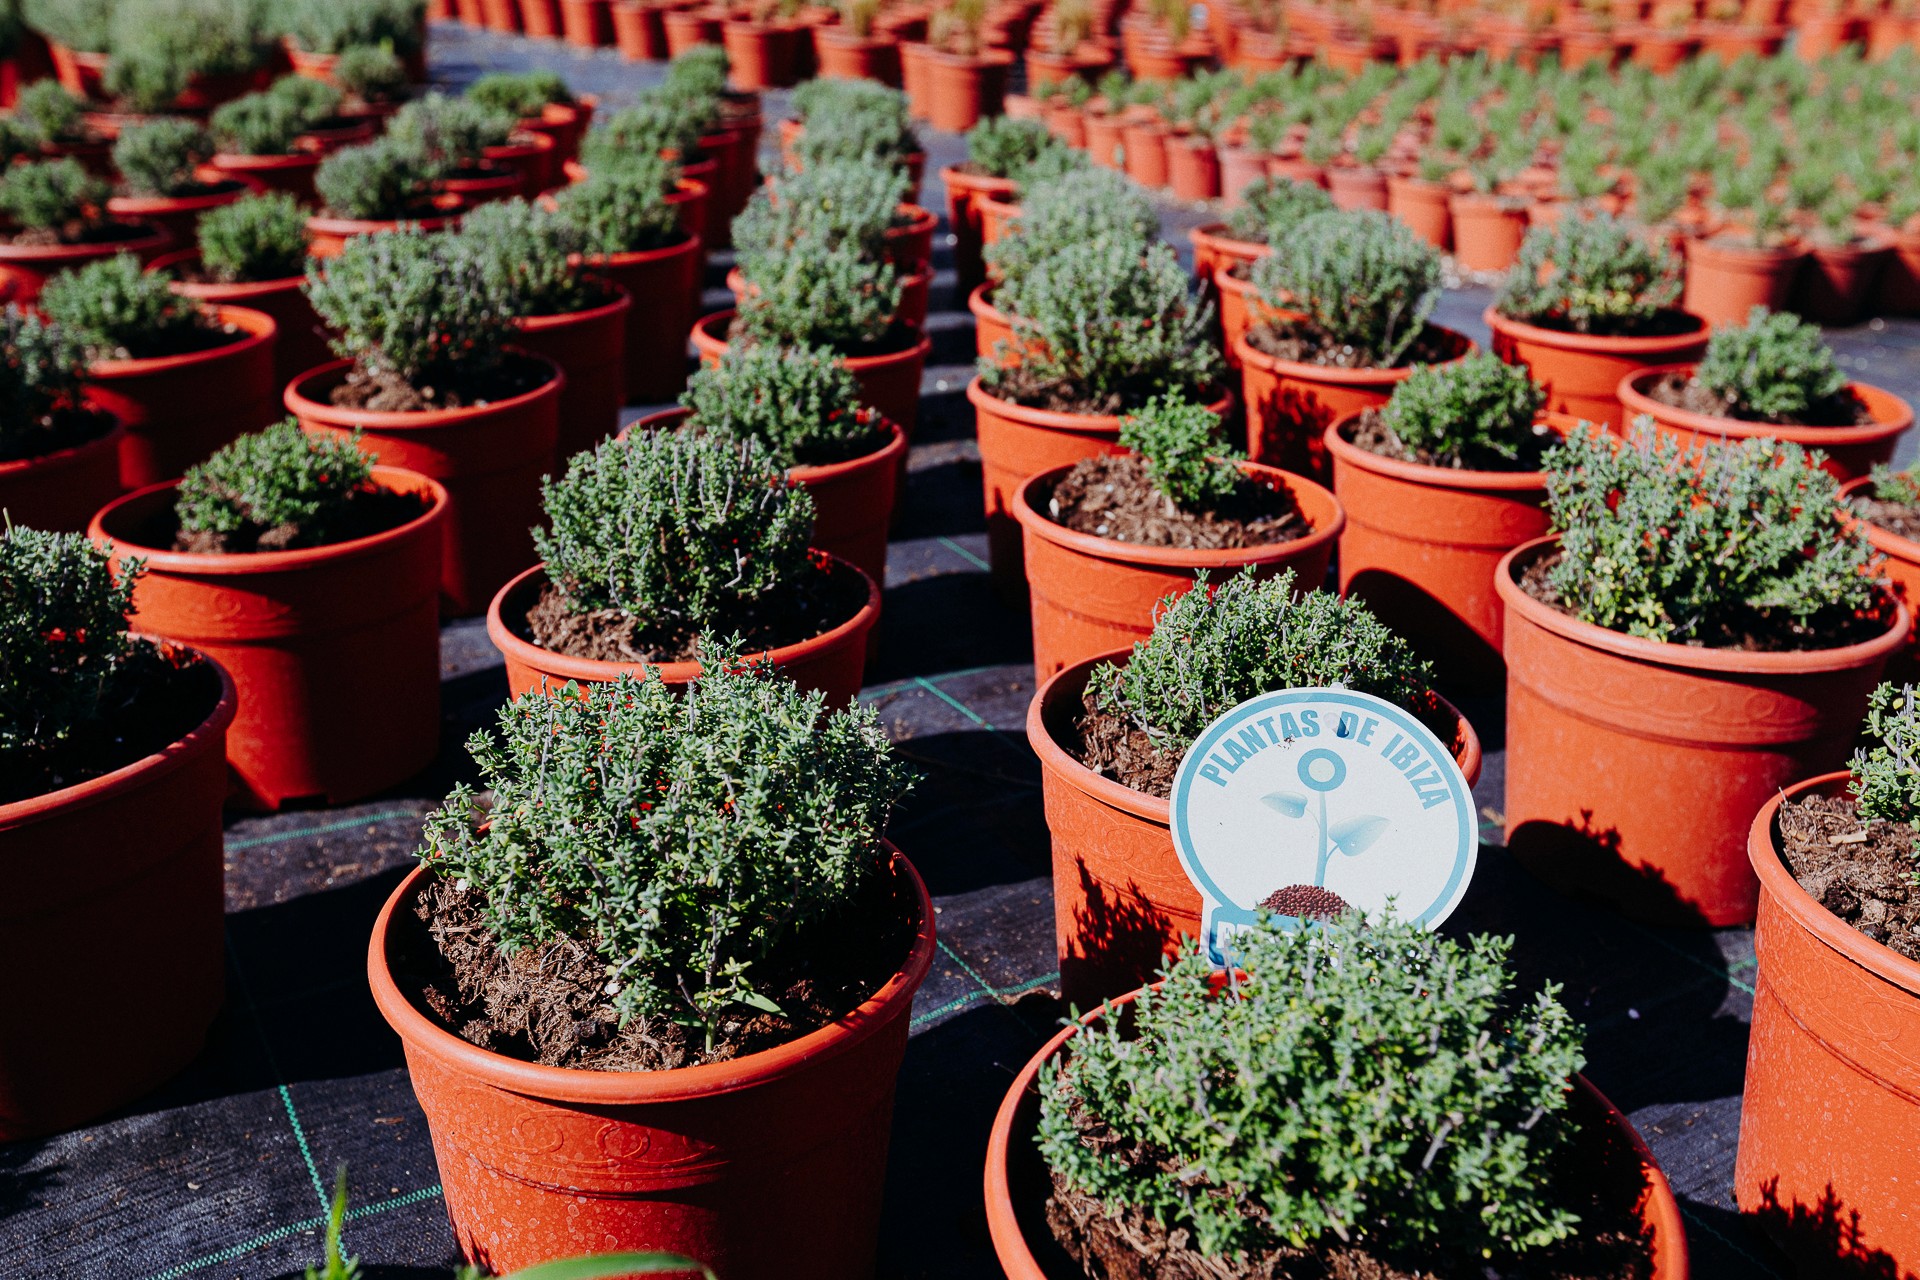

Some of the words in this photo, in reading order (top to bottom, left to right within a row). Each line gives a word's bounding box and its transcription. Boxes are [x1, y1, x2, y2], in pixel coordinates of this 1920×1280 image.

[1199, 709, 1319, 787] PLANTAS
[1337, 711, 1379, 746] DE
[1381, 733, 1452, 810] IBIZA
